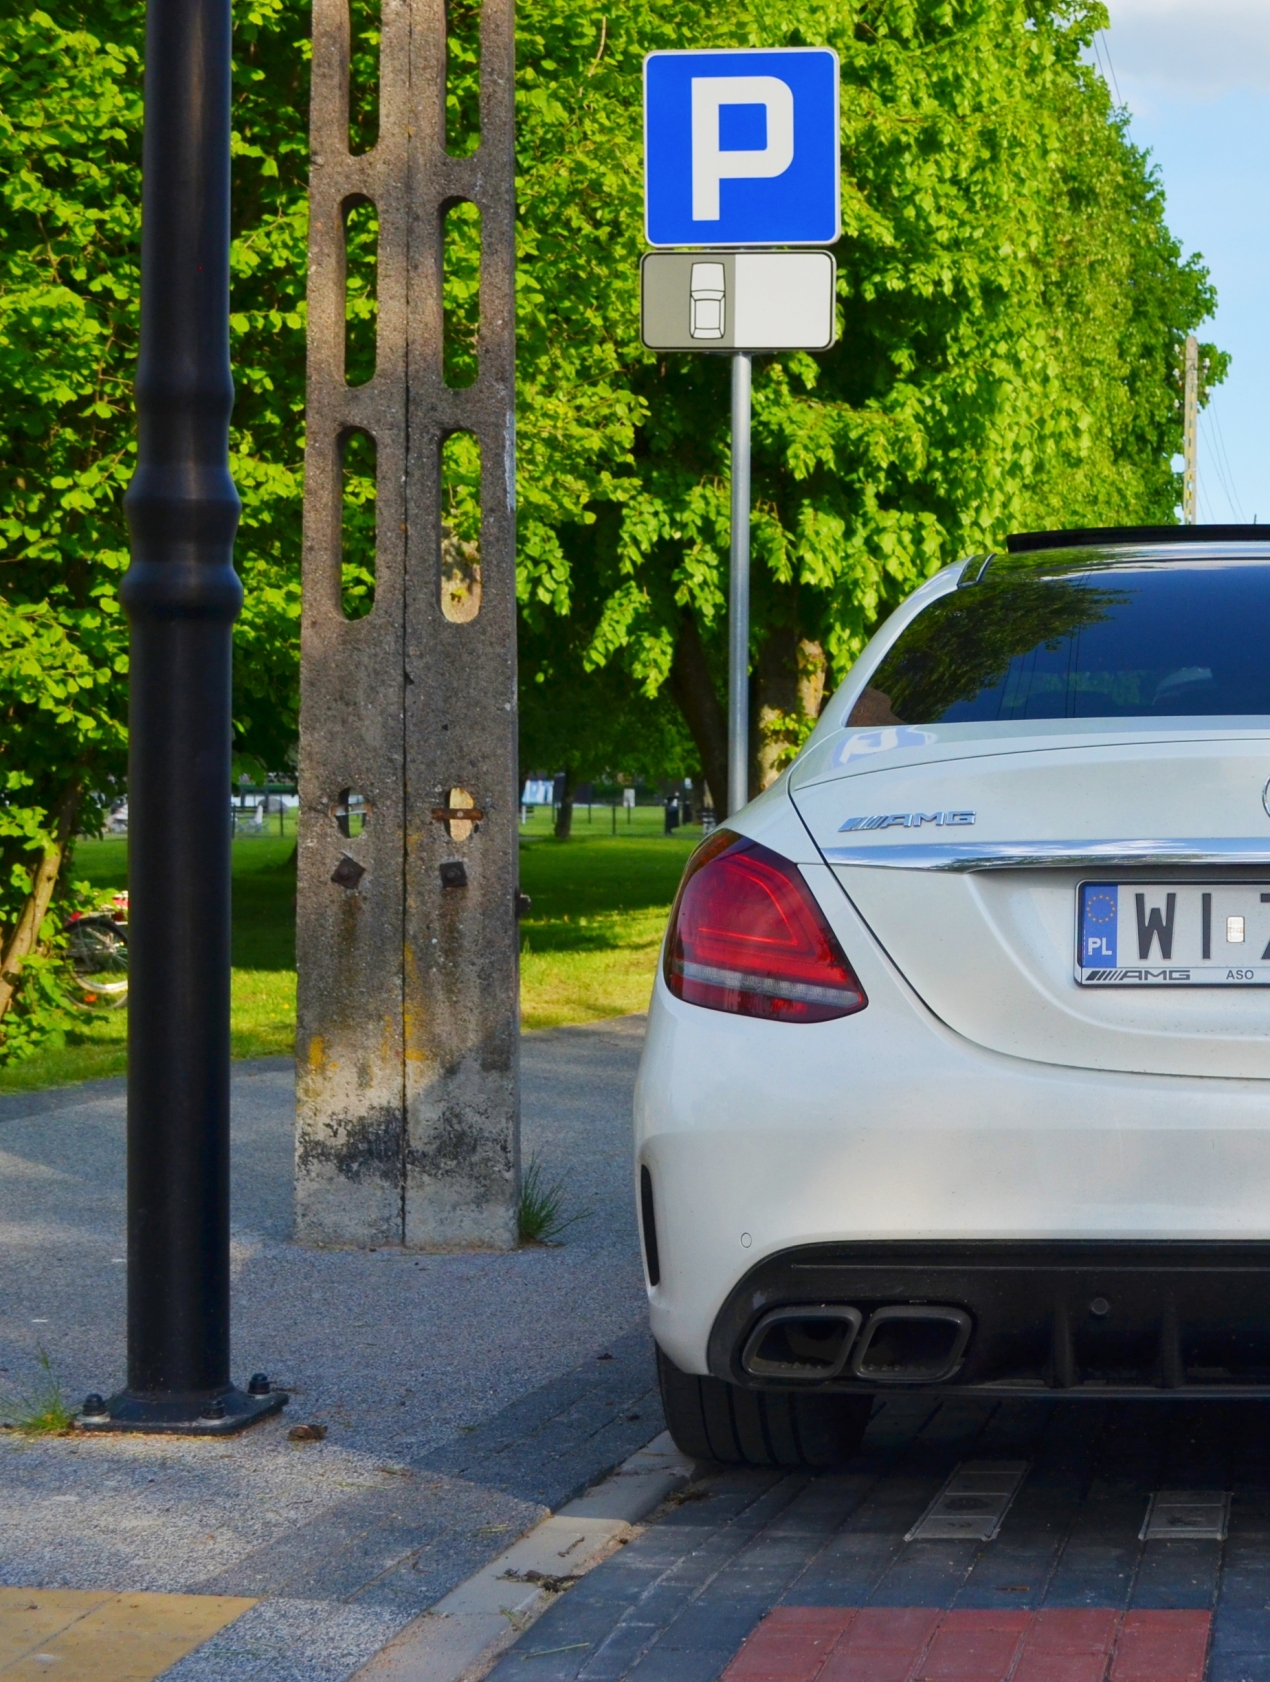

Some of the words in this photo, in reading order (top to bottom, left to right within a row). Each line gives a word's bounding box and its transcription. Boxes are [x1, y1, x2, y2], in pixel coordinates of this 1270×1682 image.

[691, 76, 794, 221] P
[881, 811, 976, 828] AMG
[1135, 893, 1211, 959] WI
[1088, 938, 1112, 955] PL
[1119, 970, 1190, 980] AMG
[1226, 970, 1254, 980] ASO
